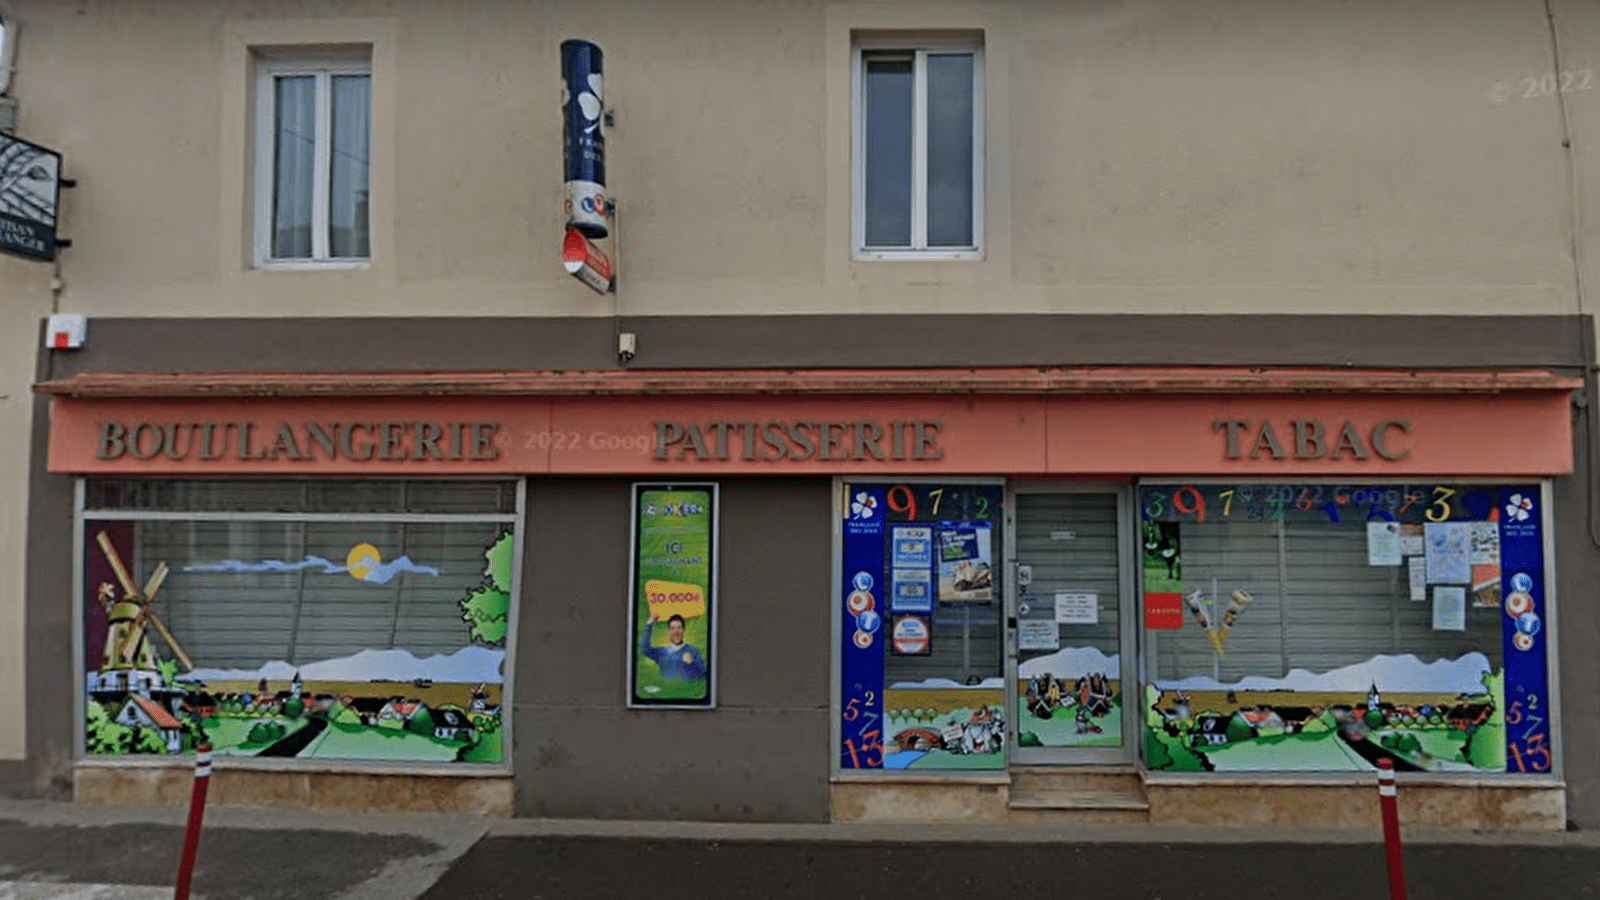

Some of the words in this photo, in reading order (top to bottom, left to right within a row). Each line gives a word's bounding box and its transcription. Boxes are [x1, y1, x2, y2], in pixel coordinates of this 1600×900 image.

[652, 420, 945, 462] PATISSERIE
[1212, 420, 1412, 461] TABAC
[887, 485, 918, 521] 9
[929, 488, 943, 516] 7
[1146, 493, 1167, 518] 3
[1172, 484, 1206, 523] 9
[1219, 490, 1235, 517] 7
[1426, 486, 1456, 522] 3
[844, 698, 861, 722] 5
[865, 690, 875, 707] 2
[1526, 693, 1538, 710] 2
[859, 711, 879, 736] 7
[1504, 700, 1523, 725] 5
[1522, 714, 1543, 740] 7
